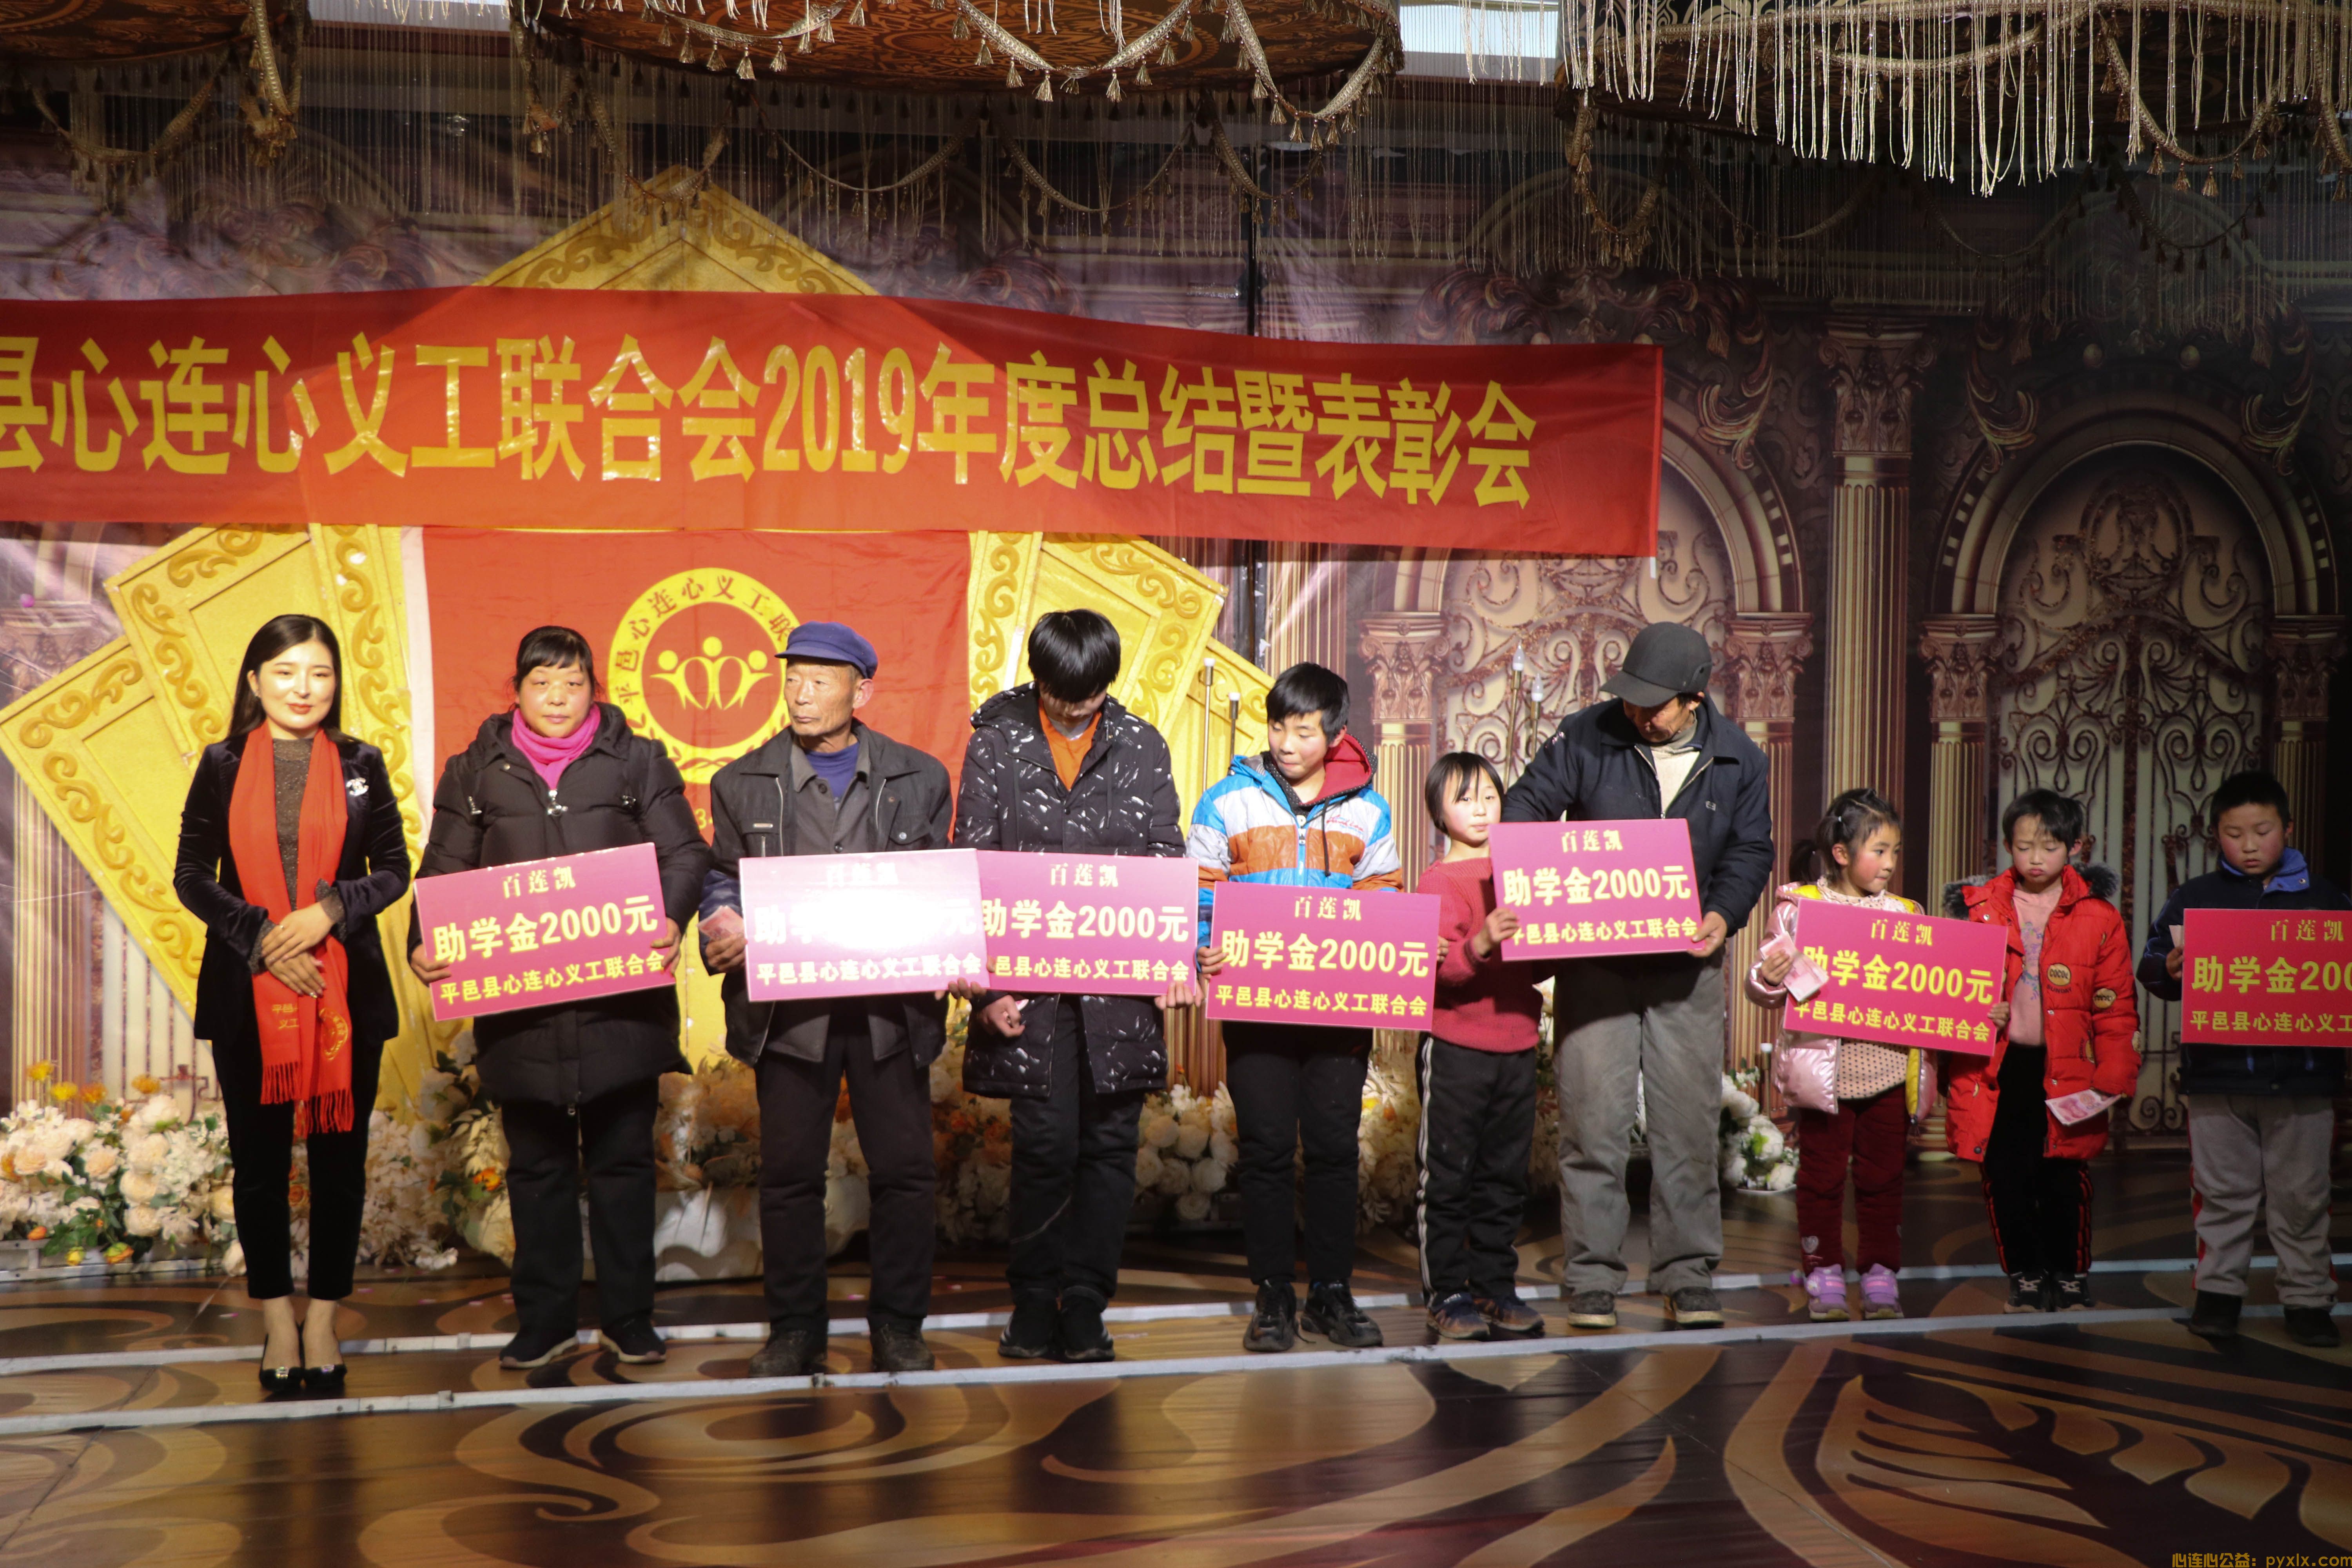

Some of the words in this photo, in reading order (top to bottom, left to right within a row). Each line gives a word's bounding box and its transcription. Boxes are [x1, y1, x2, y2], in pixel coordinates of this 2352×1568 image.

[1560, 829, 1623, 853] 百莲凯
[503, 866, 576, 898] 百莲凯
[1050, 863, 1119, 887] 百莲凯
[1503, 866, 1691, 907] 助学金2000元
[982, 898, 1189, 942] 助学金2000元
[1294, 895, 1362, 921] 百莲凯
[432, 895, 659, 964] 助学金2000元
[1871, 919, 1933, 946] 百莲凯
[2271, 918, 2344, 941] 百莲凯
[1221, 929, 1429, 978] 助学金2000元
[440, 950, 665, 1005] 平邑县心连心义工联合会
[1215, 984, 1428, 1016] 平邑县心连心义工联合会
[2190, 1011, 2352, 1033] 平邑县心连心义工
